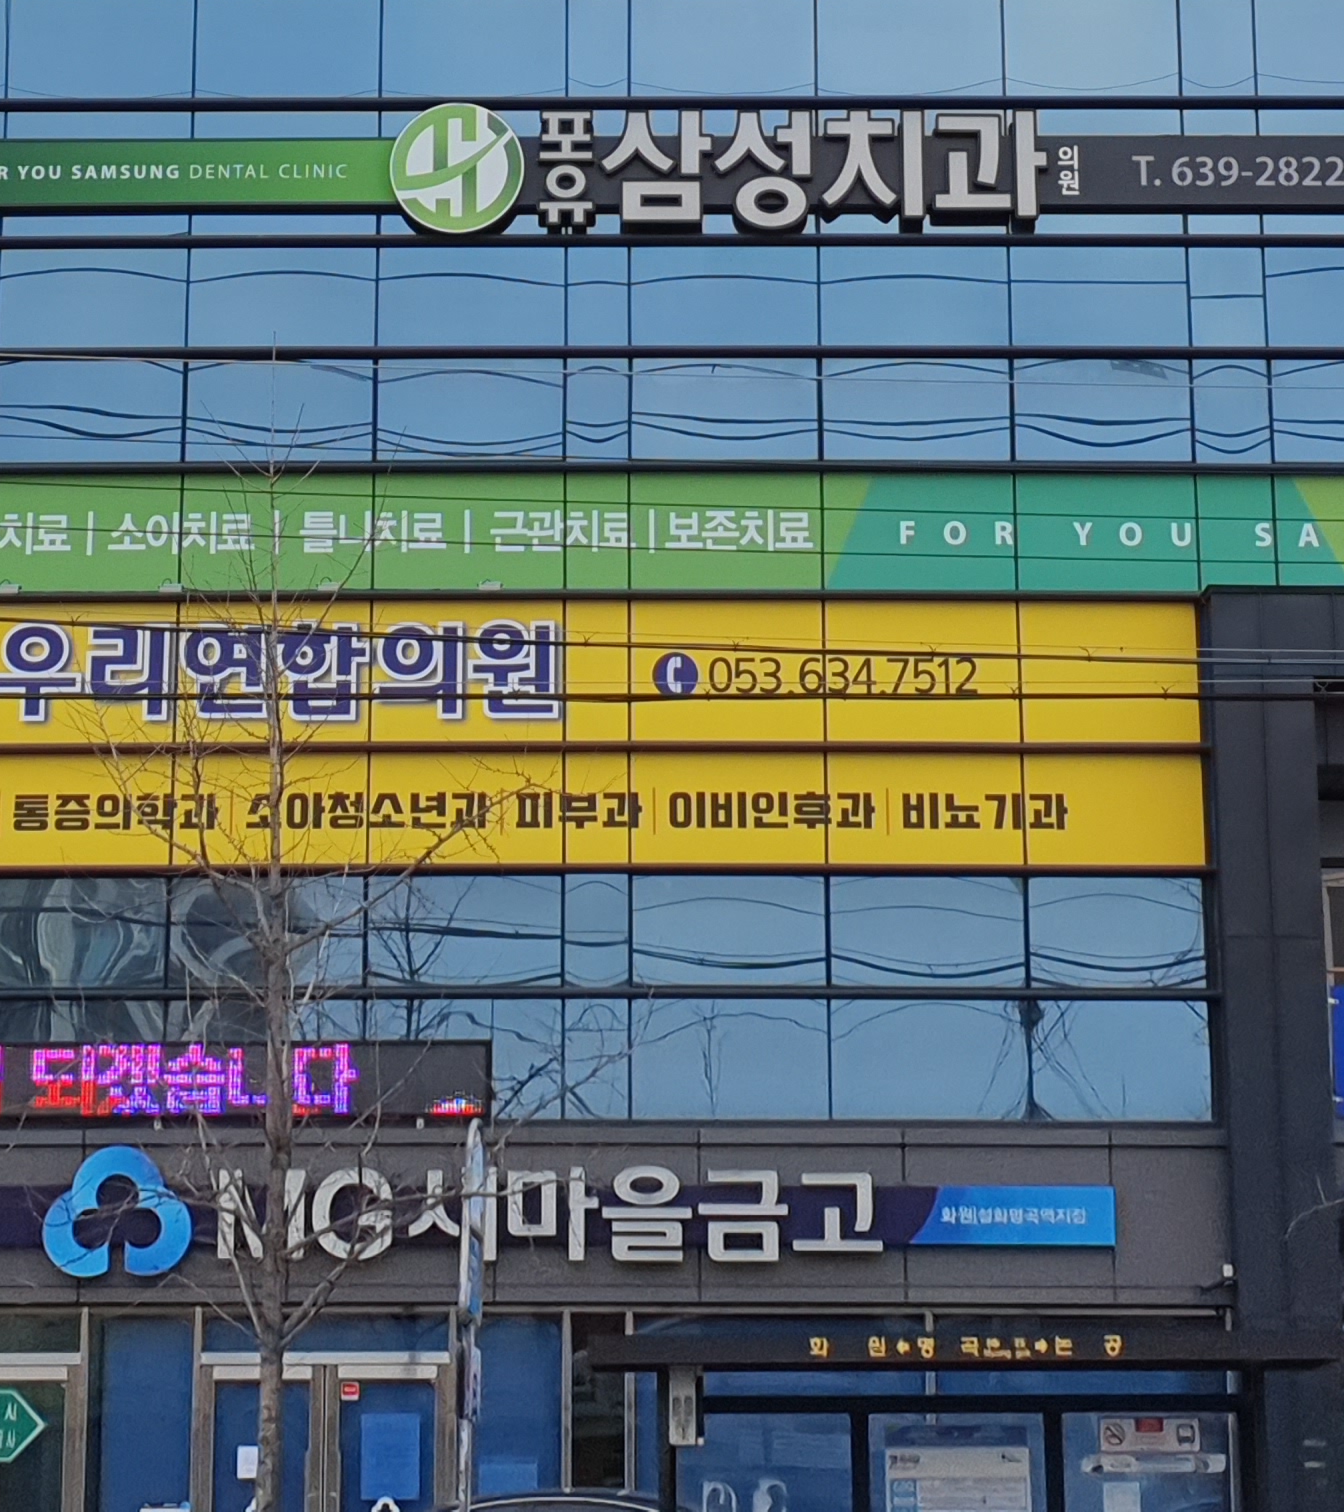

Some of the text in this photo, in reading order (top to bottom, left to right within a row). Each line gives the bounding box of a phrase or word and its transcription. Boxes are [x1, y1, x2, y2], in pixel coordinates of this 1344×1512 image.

[17, 165, 63, 181] YOU
[70, 164, 181, 181] SAMSUNG
[188, 163, 269, 180] DENTAL
[278, 162, 349, 180] CLINIC
[600, 110, 1047, 230] 삼성치과
[1058, 143, 1080, 196] 의원
[107, 510, 256, 555] 소아치료
[299, 510, 447, 554] 틀니치료
[489, 509, 637, 554] 근관치료
[664, 508, 814, 552] 보존치료
[899, 518, 1017, 548] FOR
[1072, 519, 1195, 548] YOU
[706, 654, 980, 698] 053.634.7512
[11, 791, 220, 832] 통증의학과
[514, 789, 643, 830] 피부과
[667, 790, 876, 830] 이비인후과
[902, 792, 1068, 831] 비뇨기과
